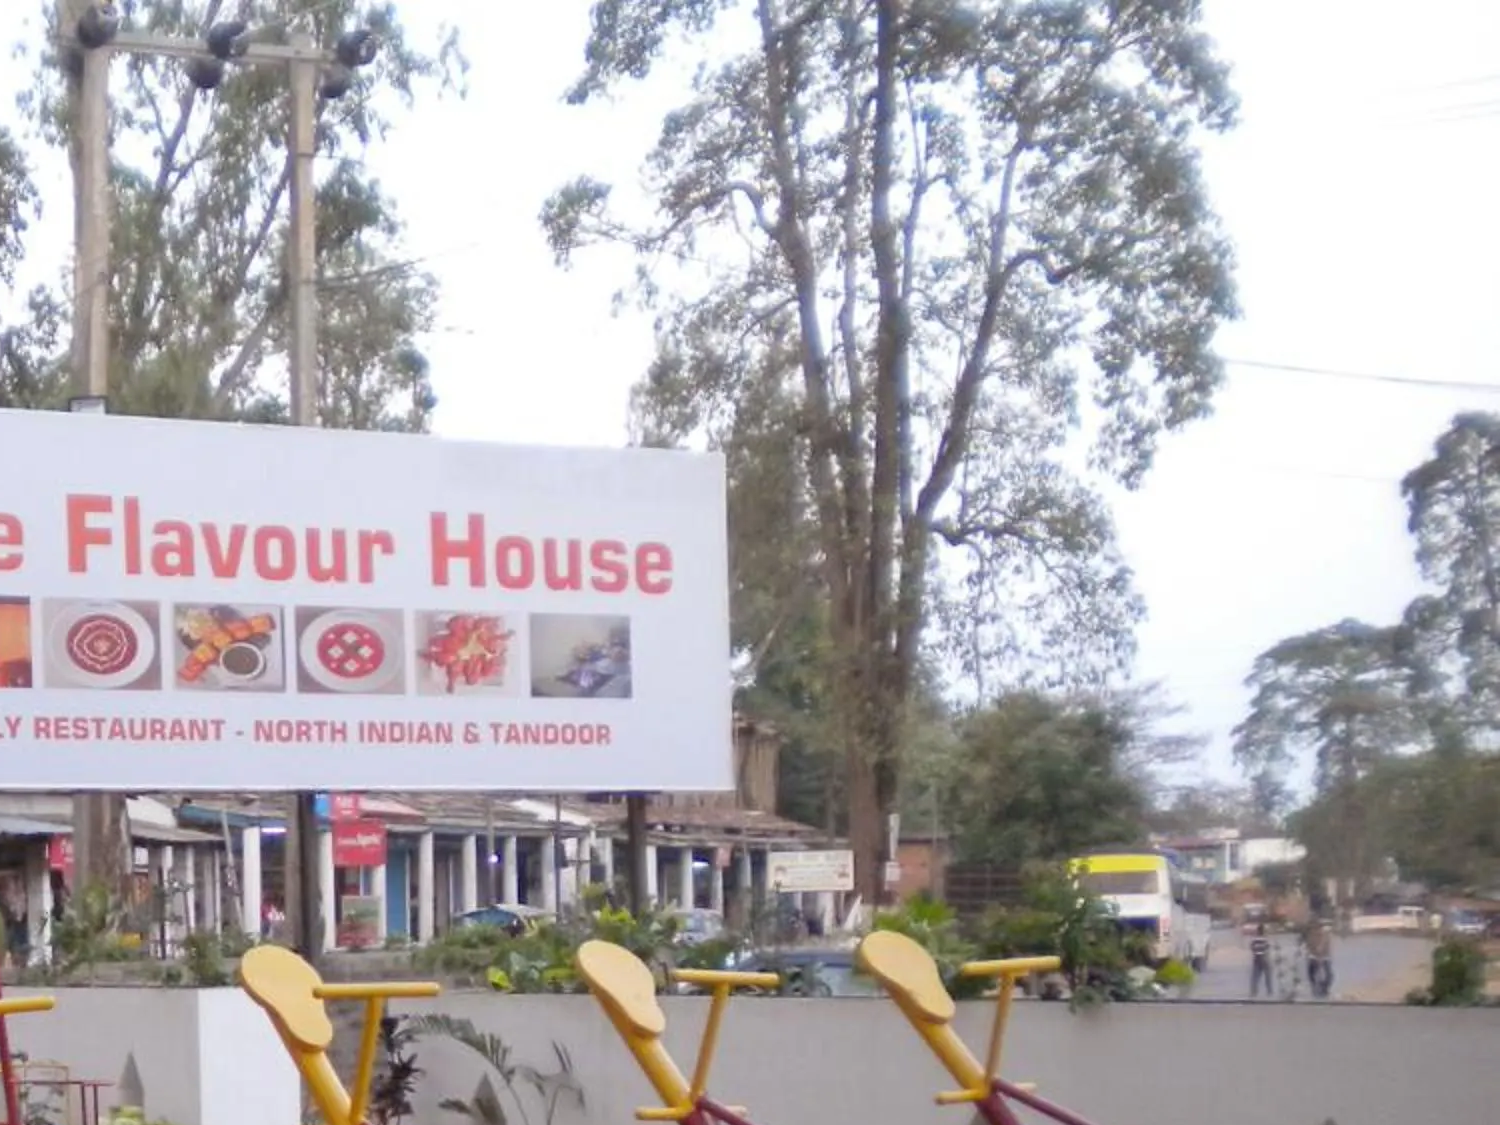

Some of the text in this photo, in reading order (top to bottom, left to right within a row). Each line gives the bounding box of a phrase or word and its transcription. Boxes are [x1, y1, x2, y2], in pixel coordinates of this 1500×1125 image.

[67, 494, 394, 583] Flavour
[429, 511, 673, 595] House
[32, 716, 226, 743] RESTAURANT
[253, 719, 348, 745] NORTH
[358, 721, 454, 746] INDIAN
[462, 723, 483, 747] &
[489, 722, 612, 747] TANDOOR
